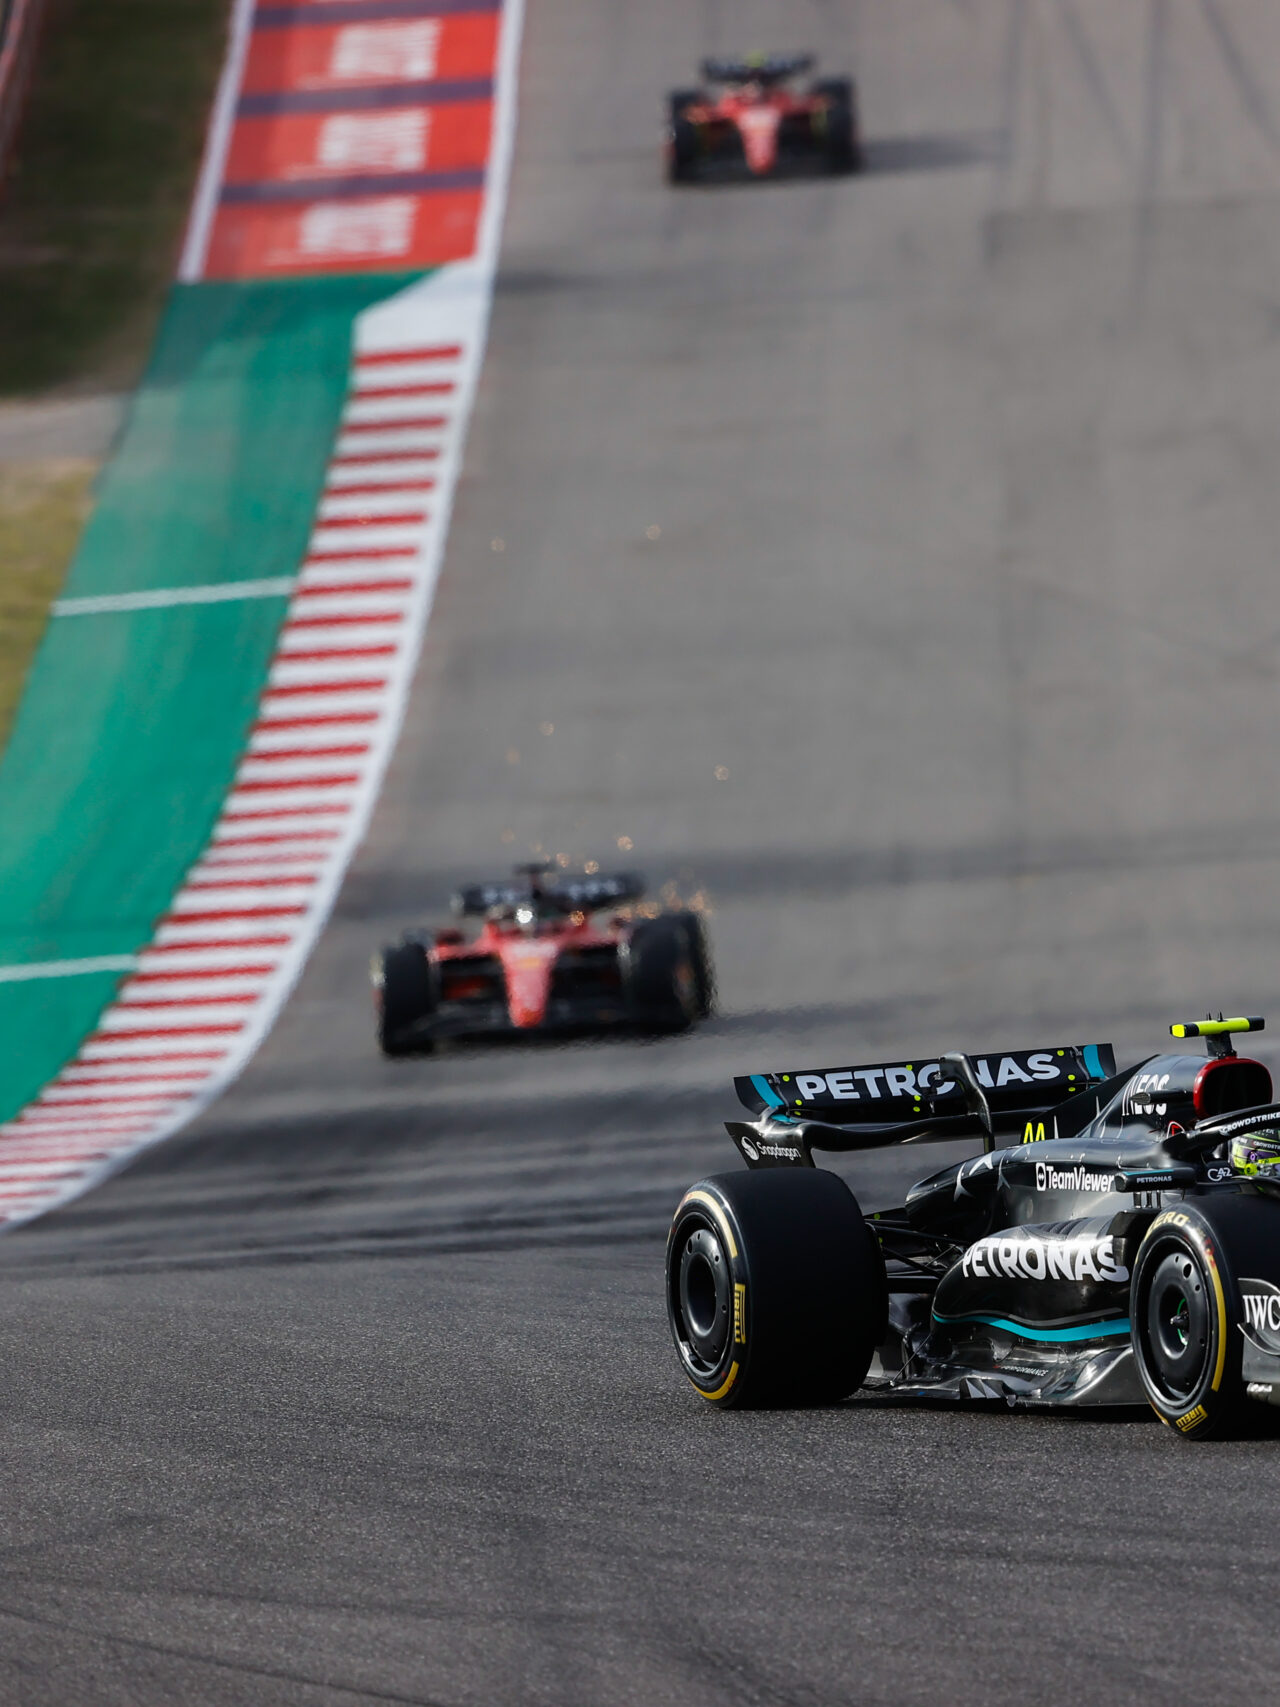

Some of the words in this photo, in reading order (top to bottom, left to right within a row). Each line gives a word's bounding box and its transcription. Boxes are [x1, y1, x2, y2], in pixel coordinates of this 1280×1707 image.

[795, 1053, 1061, 1101] PETRONAS
[1121, 1074, 1170, 1116] INEOS
[756, 1141, 801, 1161] Snapdragon
[1046, 1165, 1115, 1193] TeamViewer
[1136, 1175, 1173, 1185] PETRONAS
[1207, 1167, 1233, 1182] G42
[962, 1235, 1130, 1283] PETRONAS
[734, 1283, 746, 1344] PIRELLI
[1175, 1403, 1209, 1433] PIRELLI
